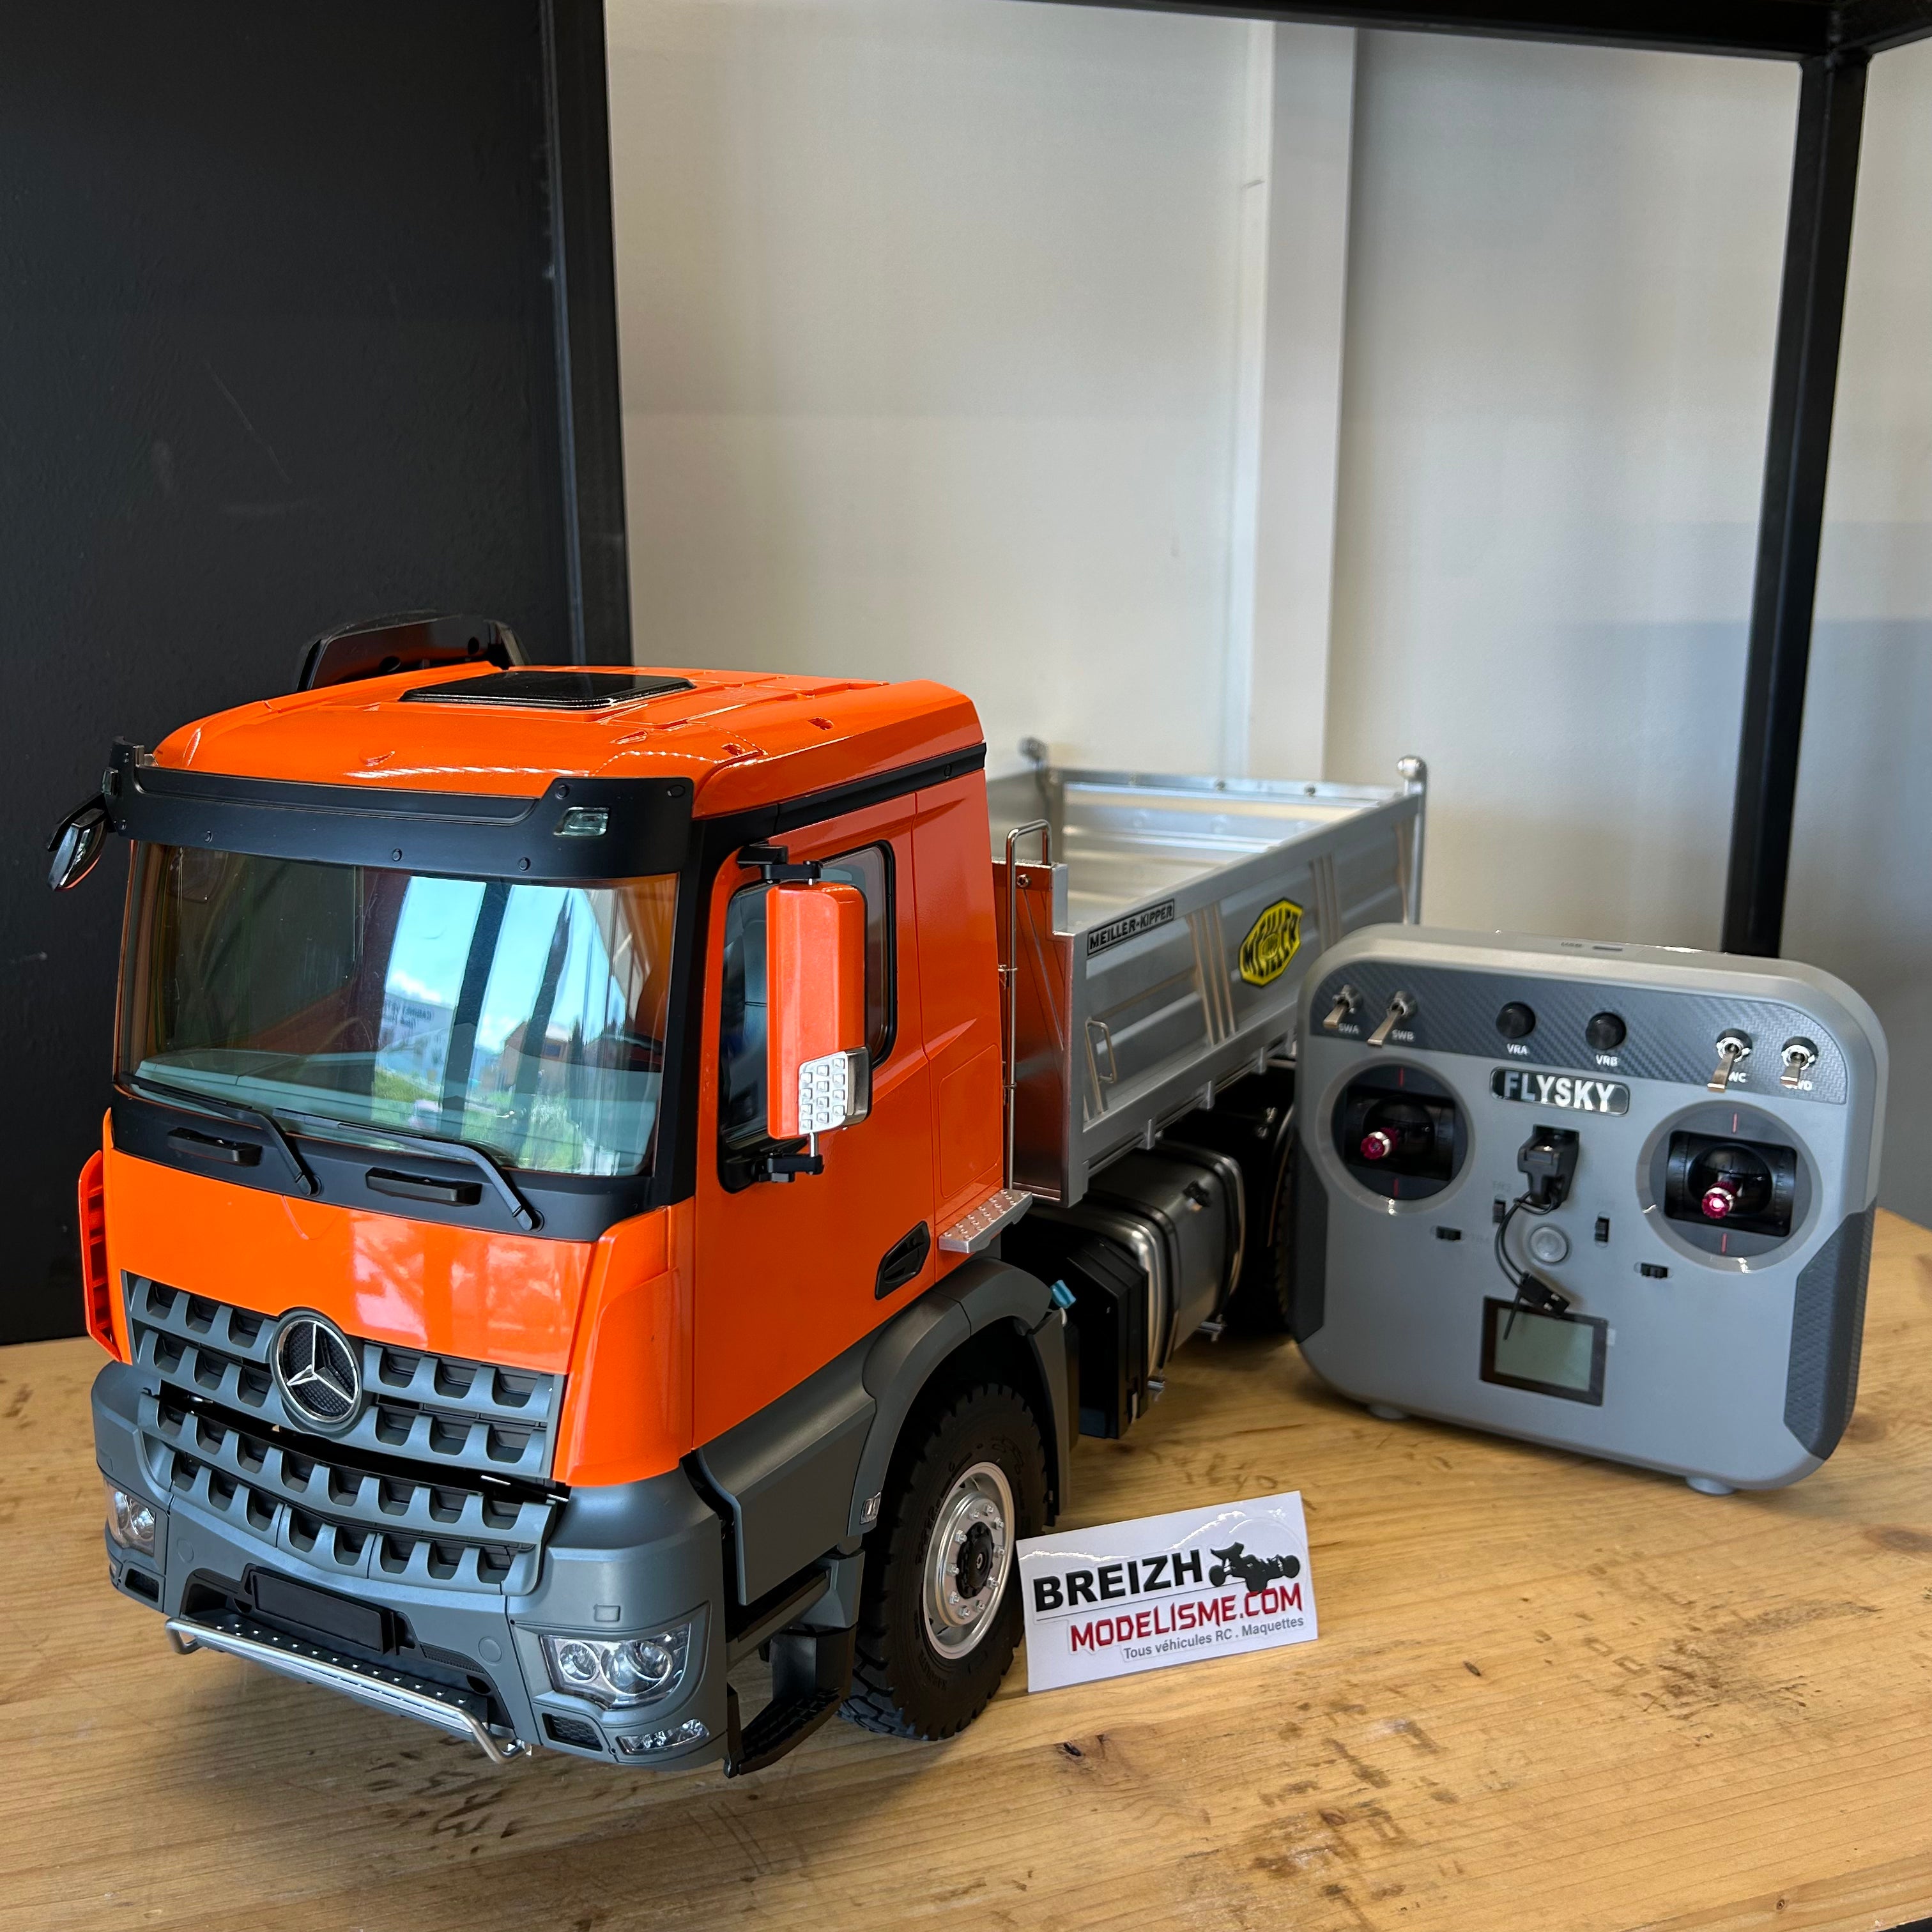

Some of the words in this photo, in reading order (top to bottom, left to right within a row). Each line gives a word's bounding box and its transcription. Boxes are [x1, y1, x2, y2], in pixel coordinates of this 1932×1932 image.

[1089, 906, 1173, 951] MEILLER-KIPPER
[1338, 1022, 1360, 1034] SWA
[1392, 1029, 1415, 1042] SWB
[1506, 1043, 1528, 1055] VRA
[1595, 1054, 1619, 1067] VRB
[1503, 1070, 1616, 1113] FLYSKY
[1032, 1549, 1204, 1613] BREIZH
[1070, 1582, 1303, 1652] MODELISME.COM
[1123, 1646, 1153, 1660] Tous
[1154, 1633, 1213, 1654] véhicules
[1215, 1629, 1233, 1642] RC
[1241, 1616, 1305, 1639] Maquettes
